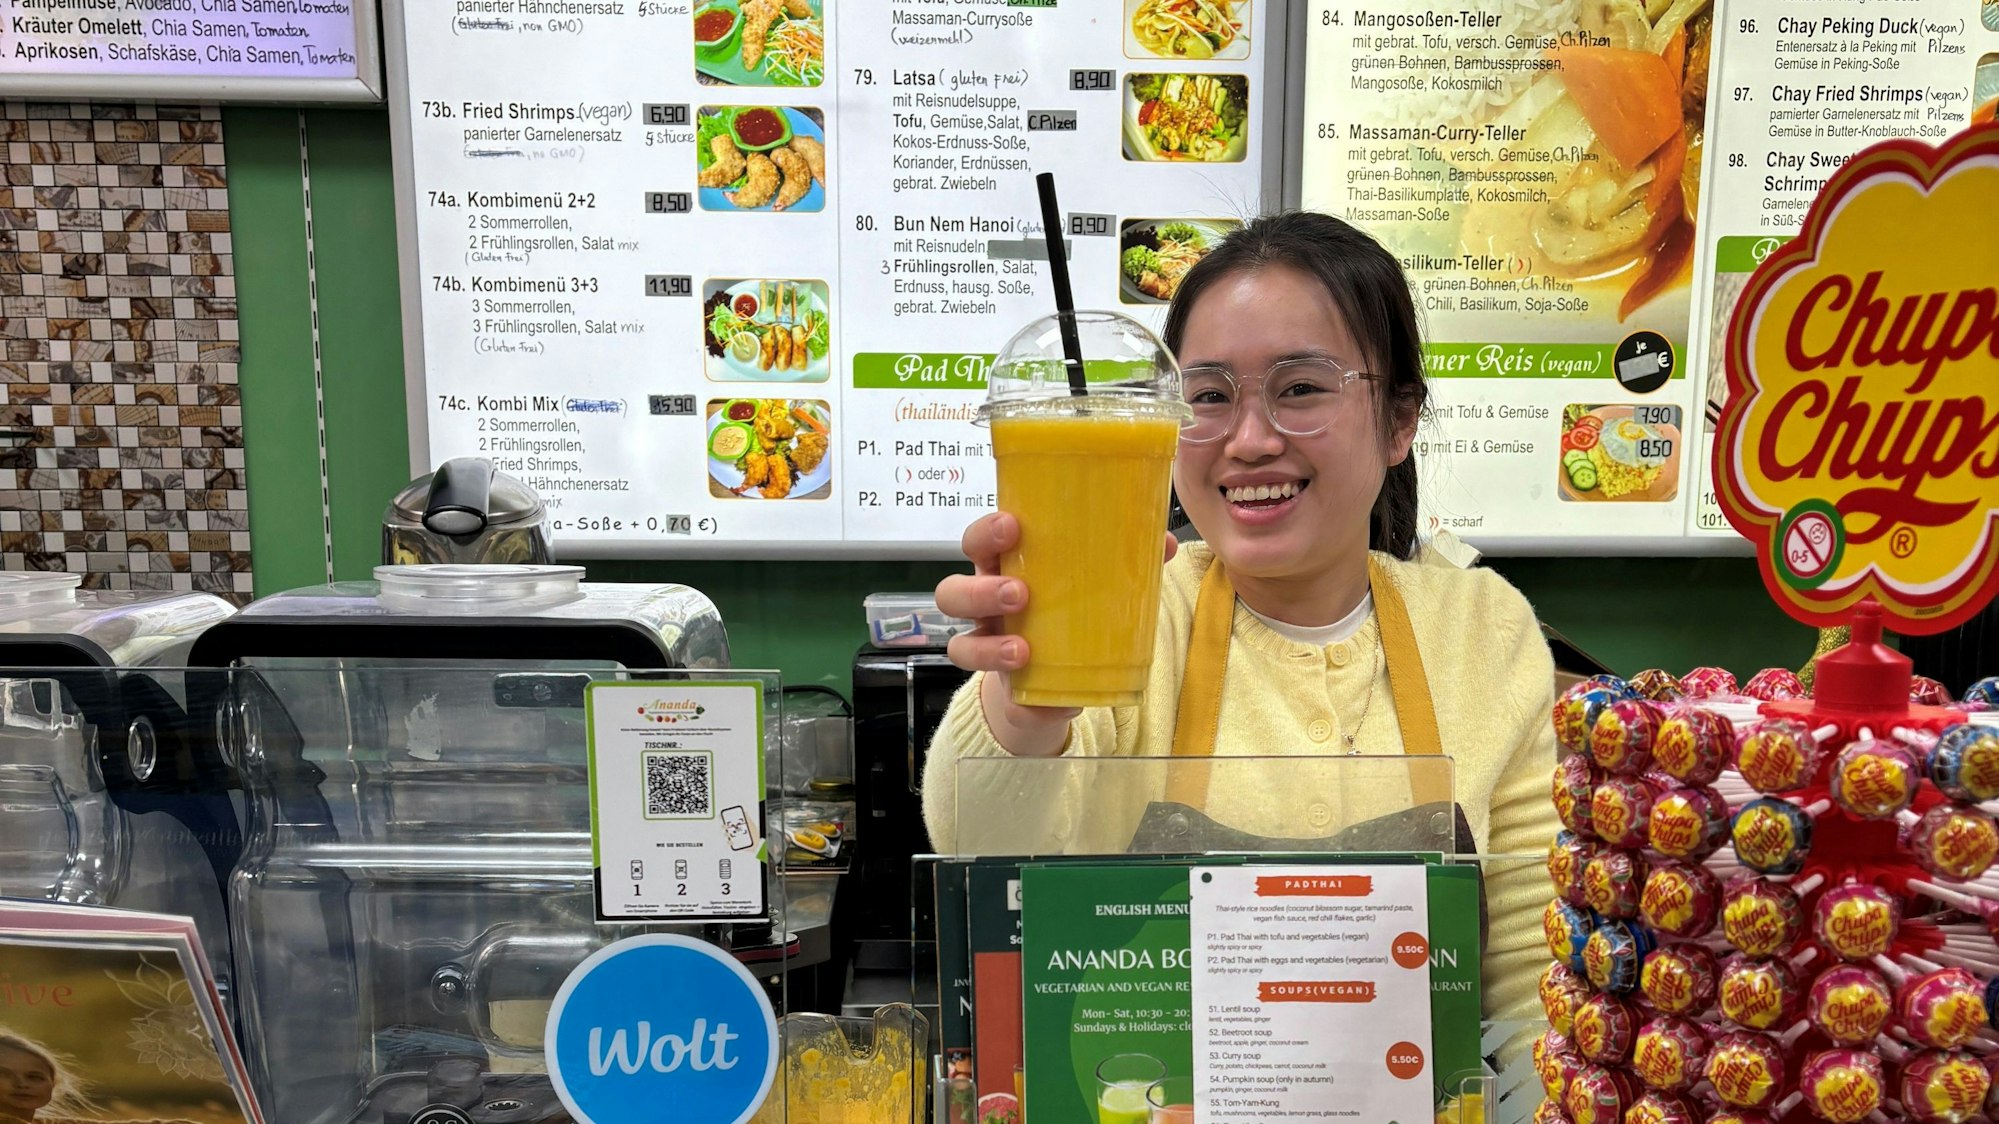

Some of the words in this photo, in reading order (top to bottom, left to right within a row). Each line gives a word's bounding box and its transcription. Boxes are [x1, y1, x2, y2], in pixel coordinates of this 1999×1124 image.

[12, 16, 73, 34] Kräuter
[78, 17, 147, 38] Omelett,
[152, 18, 187, 36] Chia
[192, 20, 249, 38] Samen,
[893, 11, 1033, 29] Massaman-Currysoße
[1322, 10, 1344, 26] 84.
[1354, 11, 1502, 30] Mangosoßen-Teller
[1739, 19, 1759, 33] 96.
[1778, 17, 1817, 37] Chay
[1822, 18, 1874, 37] Peking
[1879, 18, 1919, 34] Duck
[251, 22, 309, 38] Tomaten
[1919, 19, 1964, 40] (vegan)
[1353, 35, 1371, 49] mit
[1375, 34, 1418, 51] gebrat.
[1423, 35, 1452, 51] Tofu,
[1456, 35, 1500, 49] versch.
[1505, 35, 1560, 51] Gemüse,
[1776, 40, 1838, 53] Entenersatz
[1841, 40, 1847, 53] à
[1850, 41, 1859, 53] la
[1862, 41, 1898, 55] Peking
[1901, 41, 1916, 53] mit
[15, 42, 103, 62] Aprikosen,
[108, 43, 201, 62] Schafskäse,
[206, 45, 242, 62] Chia
[247, 46, 304, 66] Samen,
[303, 45, 356, 65] Tomaten
[854, 70, 877, 85] 79.
[894, 70, 935, 86] Latsa
[894, 94, 912, 107] mit
[916, 94, 1020, 110] Reisnudelsuppe,
[1734, 87, 1753, 101] 97.
[1772, 86, 1811, 105] Chay
[1816, 86, 1855, 101] Fried
[1859, 86, 1923, 105] Shrimps
[1925, 86, 1968, 108] (vegan)
[423, 102, 456, 118] 73b.
[463, 103, 503, 119] Fried
[894, 114, 926, 131] Tofu,
[464, 127, 520, 142] panierter
[1318, 124, 1340, 138] 85.
[1350, 124, 1526, 144] Massaman-Curry-Teller
[1768, 125, 1812, 137] Gemüse
[1815, 125, 1824, 137] in
[1828, 125, 1947, 138] Butter-Knoblauch-Soße
[894, 135, 1031, 151] Kokos-Erdnuss-Soße,
[894, 155, 957, 171] Koriander,
[962, 156, 1032, 171] Erdnüssen,
[428, 192, 460, 208] 74a.
[468, 191, 563, 208] Kombimenü
[568, 193, 596, 209] 2+2
[1347, 187, 1473, 203] Thai-Basilikumplatte,
[1477, 188, 1551, 204] Kokosmilch,
[468, 215, 477, 229] 2
[480, 215, 573, 231] Sommerrollen,
[856, 215, 878, 231] 80.
[894, 216, 924, 232] Bun
[931, 216, 965, 232] Nem
[971, 217, 1014, 232] Hanoi
[881, 260, 891, 274] 3
[895, 260, 998, 277] Frühlingsrollen,
[1003, 261, 1038, 276] Salat,
[433, 276, 466, 292] 74b.
[472, 277, 566, 293] Kombimenü
[571, 278, 598, 293] 3+3
[473, 320, 481, 333] 3
[485, 320, 581, 337] Frühlingsrollen,
[585, 321, 617, 334] Salat
[621, 320, 645, 334] mix
[1785, 271, 1999, 394] Chup
[1636, 341, 1647, 354] je
[894, 355, 948, 382] Pad
[954, 355, 988, 382] Th
[1476, 344, 1533, 375] Reis
[1541, 351, 1602, 377] (vegan)
[438, 396, 471, 412] 74c.
[478, 399, 528, 412] Kombi
[533, 397, 560, 411] Mix
[1435, 406, 1454, 419] mit
[1457, 405, 1482, 419] Tofu
[1486, 405, 1495, 419] &
[1498, 405, 1549, 419] Gemüse
[858, 441, 881, 456] P1.
[895, 441, 924, 456] Pad
[929, 441, 961, 456] Thai
[965, 444, 984, 457] mit
[1433, 440, 1451, 453] mit
[1455, 440, 1467, 453] Ei
[1471, 440, 1479, 453] &
[1483, 440, 1534, 453] Gemüse
[631, 520, 639, 529] +
[1452, 516, 1483, 528] scharf
[634, 884, 642, 896] 1
[677, 884, 687, 896] 2
[721, 883, 731, 895] 3
[1096, 904, 1152, 916] ENGLISH
[1207, 933, 1219, 941] P1.
[1221, 933, 1235, 941] Pad
[1237, 933, 1252, 941] Thai
[1253, 933, 1268, 941] with
[1270, 933, 1285, 941] tofu
[1286, 933, 1300, 941] and
[1301, 933, 1341, 942] vegetables
[1342, 933, 1369, 943] (vegan)
[1047, 949, 1154, 971] ANANDA
[1035, 983, 1105, 993] VEGETARIAN
[1107, 982, 1132, 993] AND
[1135, 981, 1173, 993] VEGAN
[1113, 1009, 1134, 1021] Sat,
[1136, 1009, 1163, 1020] 10:30
[1074, 1022, 1117, 1035] Sundays
[1119, 1022, 1127, 1032] &
[1129, 1021, 1177, 1034] Holidays:
[1209, 1029, 1220, 1037] 52.
[1222, 1029, 1253, 1037] Beetroot
[588, 1018, 739, 1076] Wolt
